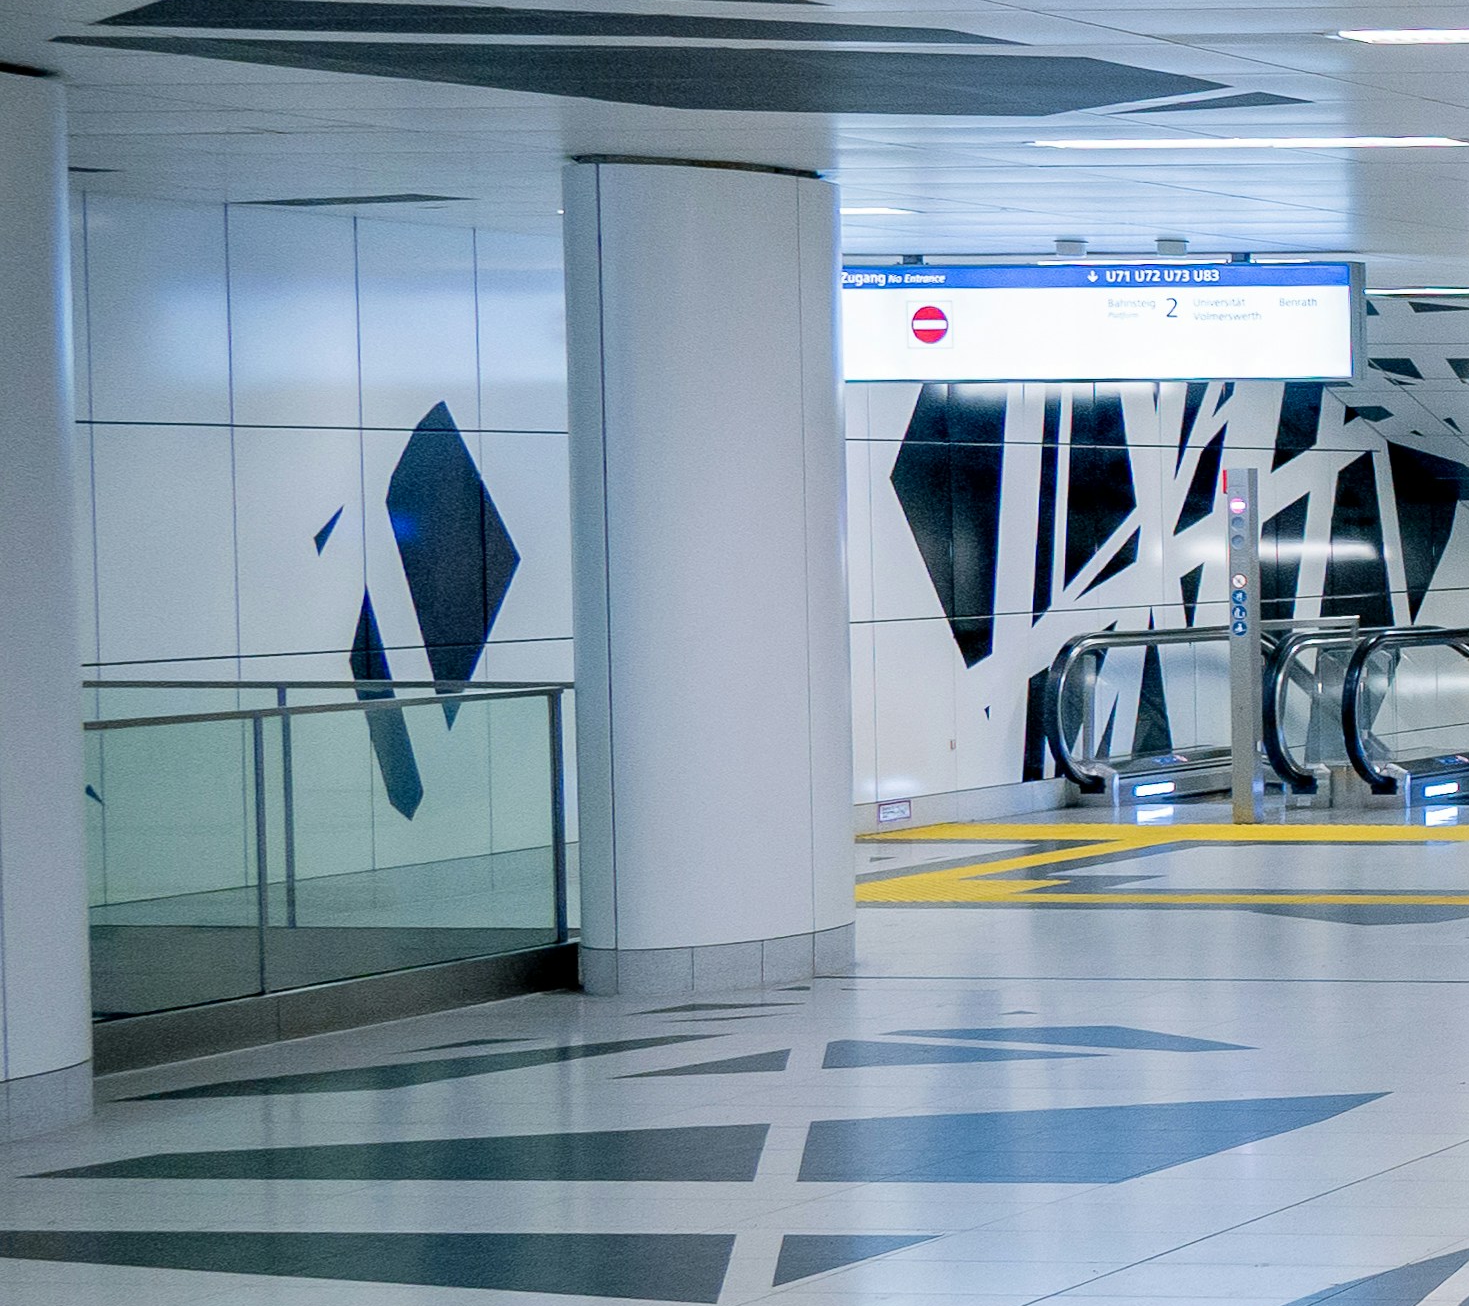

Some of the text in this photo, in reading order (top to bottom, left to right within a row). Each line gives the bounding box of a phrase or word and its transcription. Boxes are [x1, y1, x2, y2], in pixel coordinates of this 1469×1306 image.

[841, 271, 946, 286] Zugang No Entrance
[1106, 269, 1220, 282] U71 U72 U73 U83
[1108, 298, 1156, 309] Bahnsteig
[1166, 298, 1178, 318] 2
[1193, 298, 1245, 308] Universität
[1279, 297, 1318, 307] Benrath
